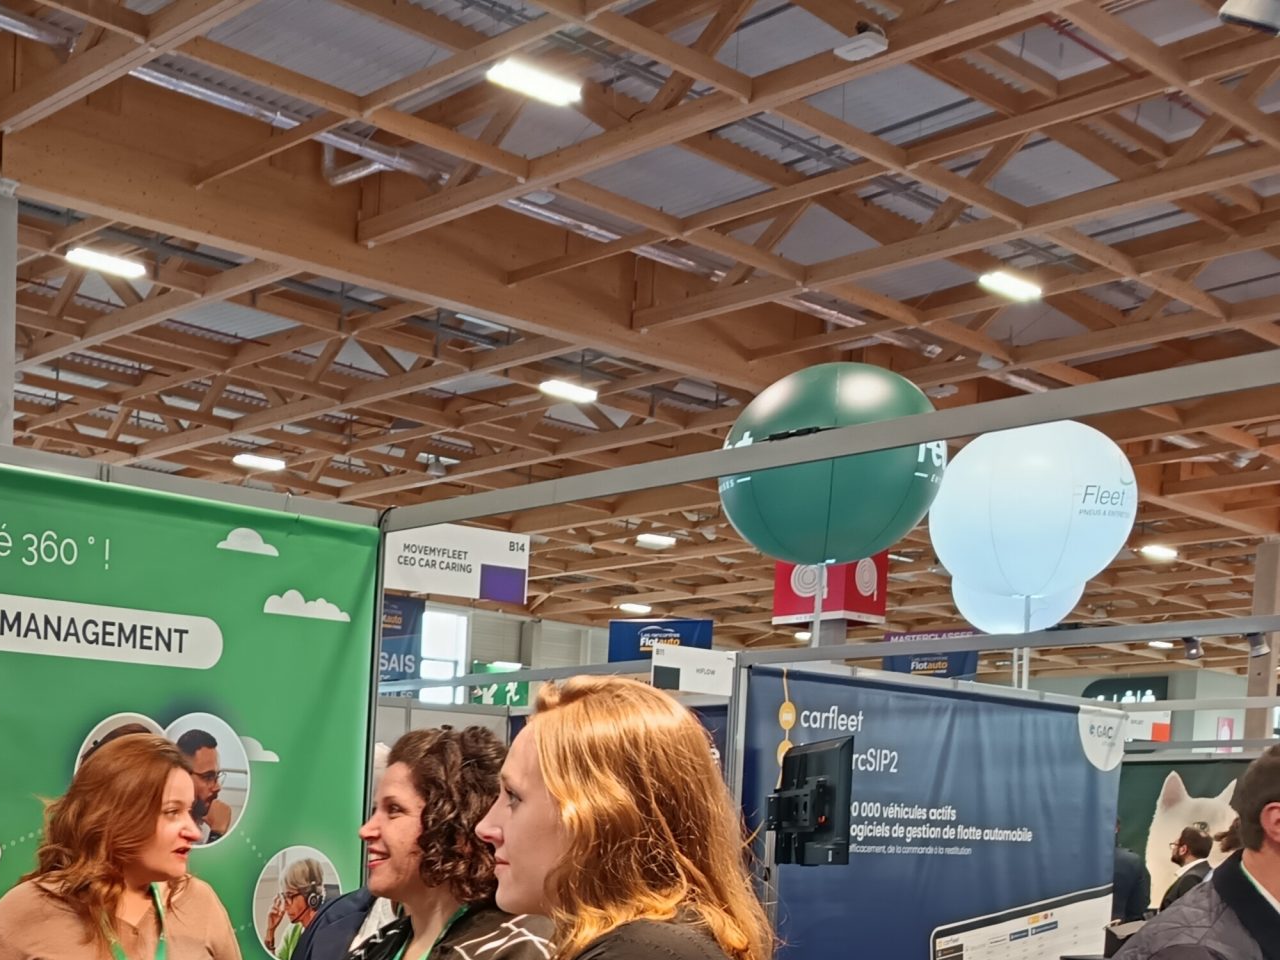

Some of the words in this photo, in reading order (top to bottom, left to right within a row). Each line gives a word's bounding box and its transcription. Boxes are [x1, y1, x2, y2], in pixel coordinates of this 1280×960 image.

[1082, 484, 1126, 507] Fleet
[402, 543, 469, 561] MOVEMYFLEET
[508, 540, 525, 553] B14
[397, 554, 417, 566] CEO
[418, 557, 437, 569] CAR
[438, 560, 472, 574] CARING
[0, 609, 190, 654] MANAGEMENT
[380, 651, 415, 673] SAIS
[910, 661, 948, 671] Flotauto
[800, 705, 864, 732] carfleet
[851, 748, 898, 773] rcSIP2
[860, 802, 881, 818] 000
[882, 803, 927, 820] véhicules
[928, 804, 957, 821] actifs
[850, 820, 890, 842] ogiciels
[891, 822, 904, 838] de
[905, 823, 941, 843] gestion
[942, 824, 956, 840] de
[956, 825, 982, 841] flotte
[983, 827, 1033, 843] automobile
